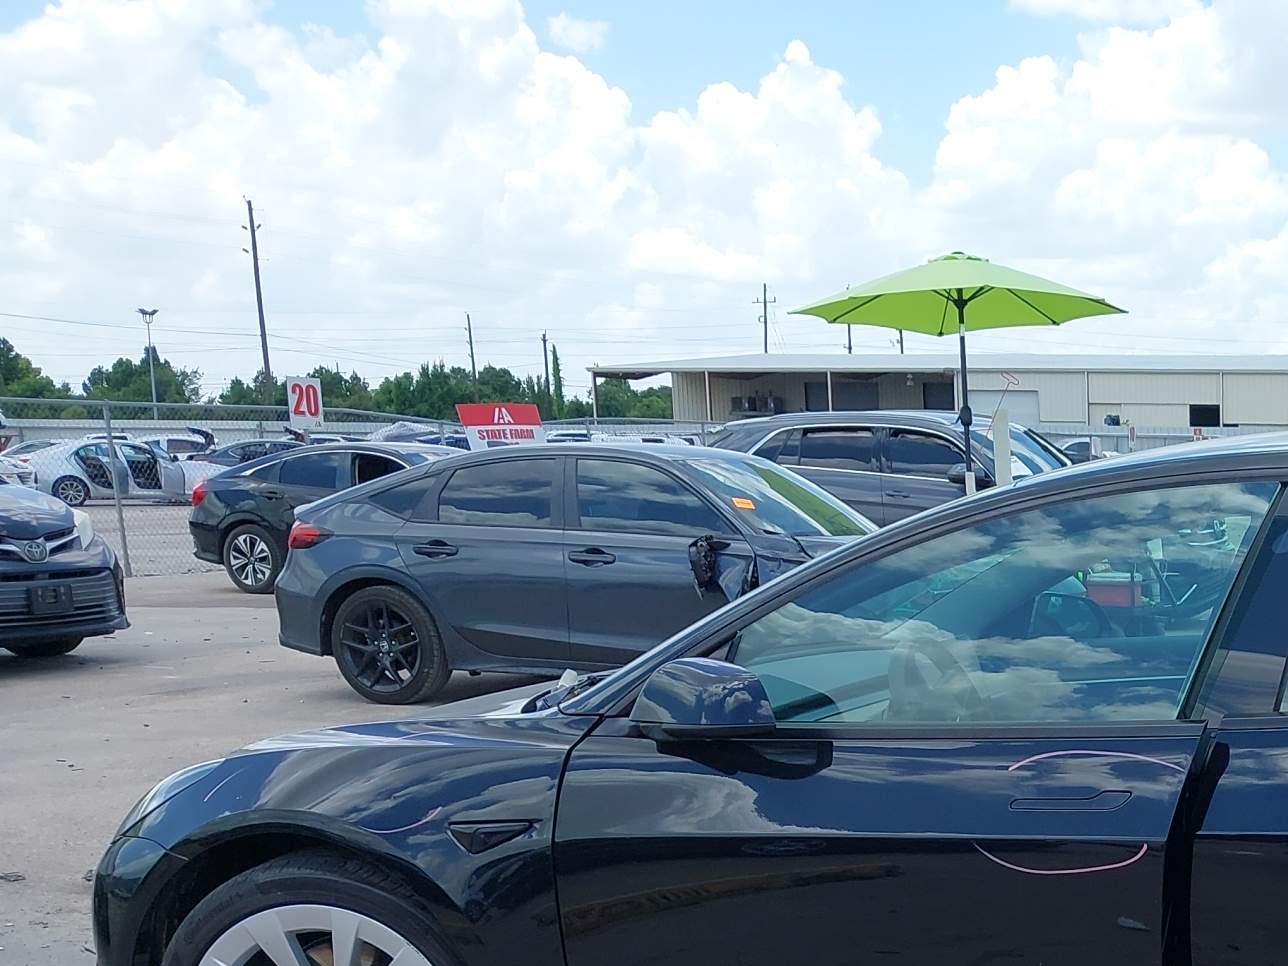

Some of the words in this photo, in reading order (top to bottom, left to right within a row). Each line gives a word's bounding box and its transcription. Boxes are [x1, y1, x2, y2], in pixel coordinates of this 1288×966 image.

[291, 383, 319, 416] 20
[477, 429, 509, 440] STATE
[510, 429, 535, 440] FARM
